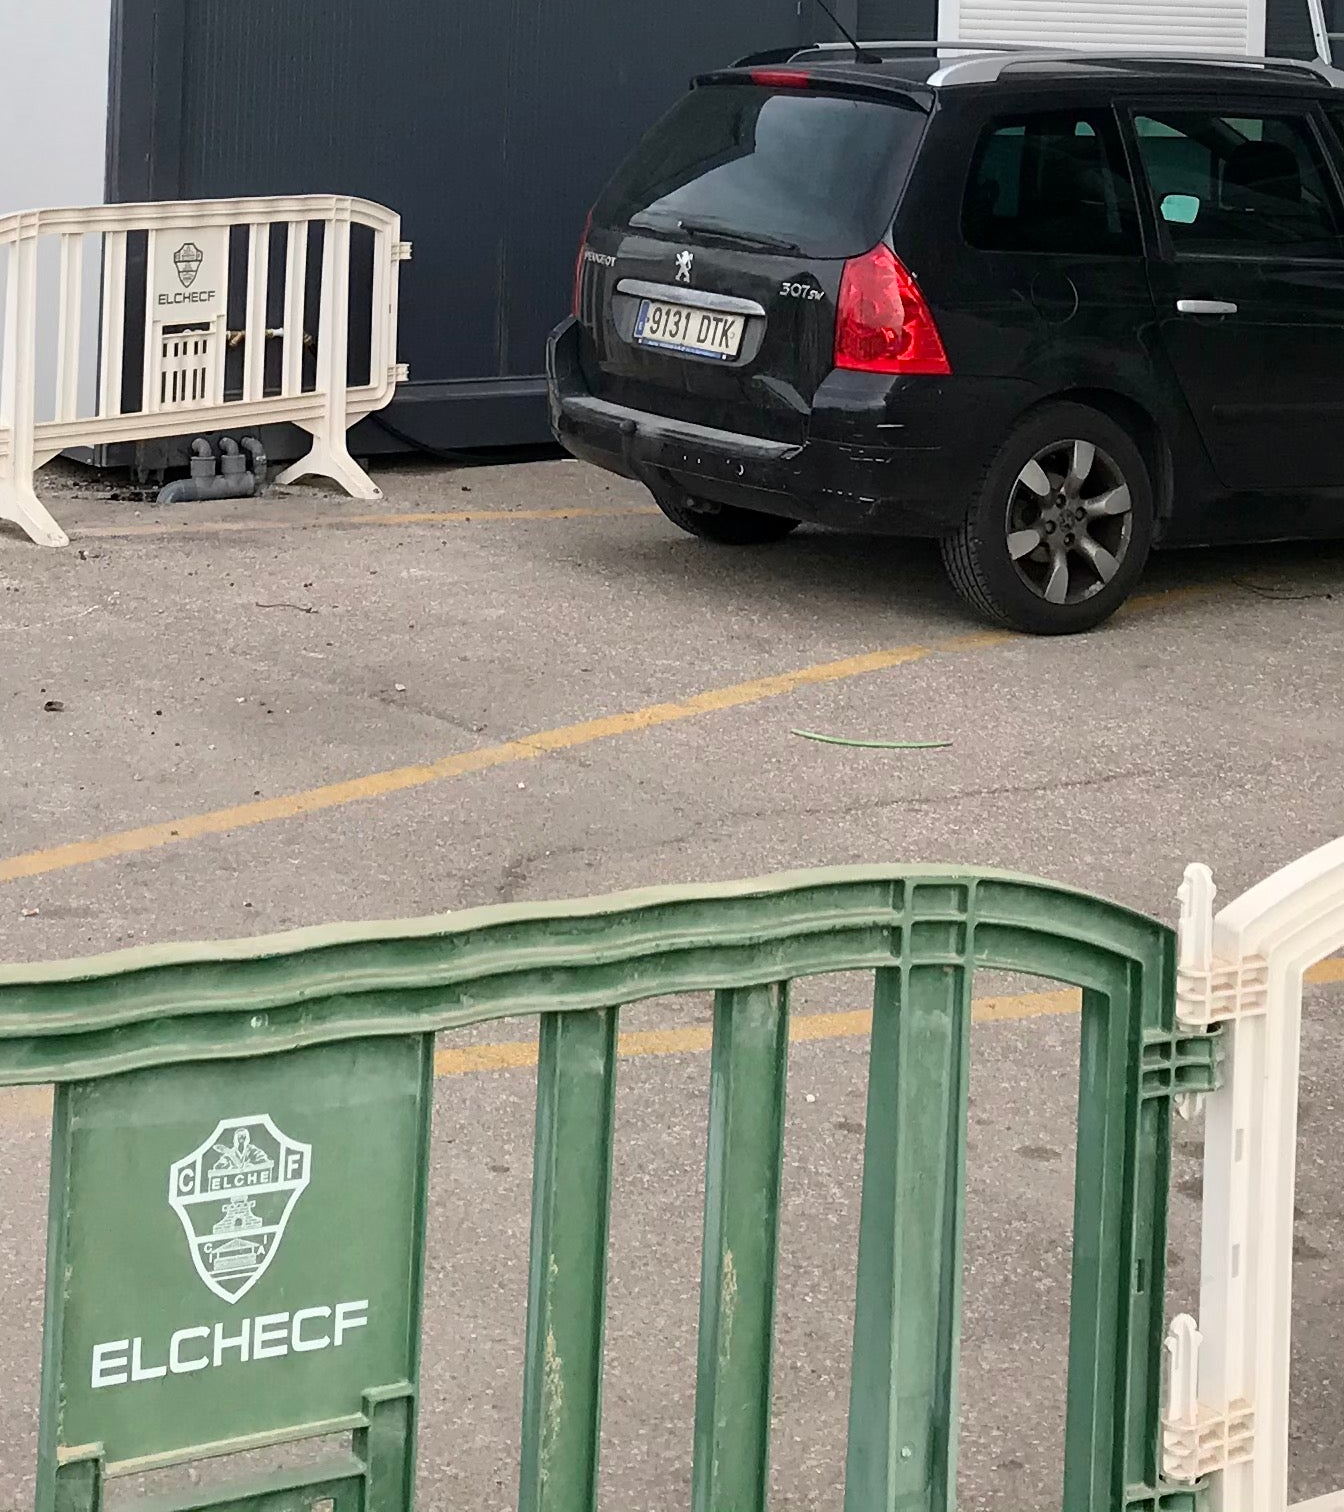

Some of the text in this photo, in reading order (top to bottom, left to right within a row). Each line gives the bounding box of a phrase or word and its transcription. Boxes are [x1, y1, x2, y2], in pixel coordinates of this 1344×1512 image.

[584, 251, 617, 268] PEUGEOT
[158, 290, 216, 305] ELCHECF
[649, 307, 692, 341] 9131
[696, 314, 736, 349] DTK
[286, 1154, 301, 1179] F
[178, 1168, 194, 1193] C
[211, 1170, 270, 1190] ELCHE
[90, 1299, 369, 1389] ELCHECF
